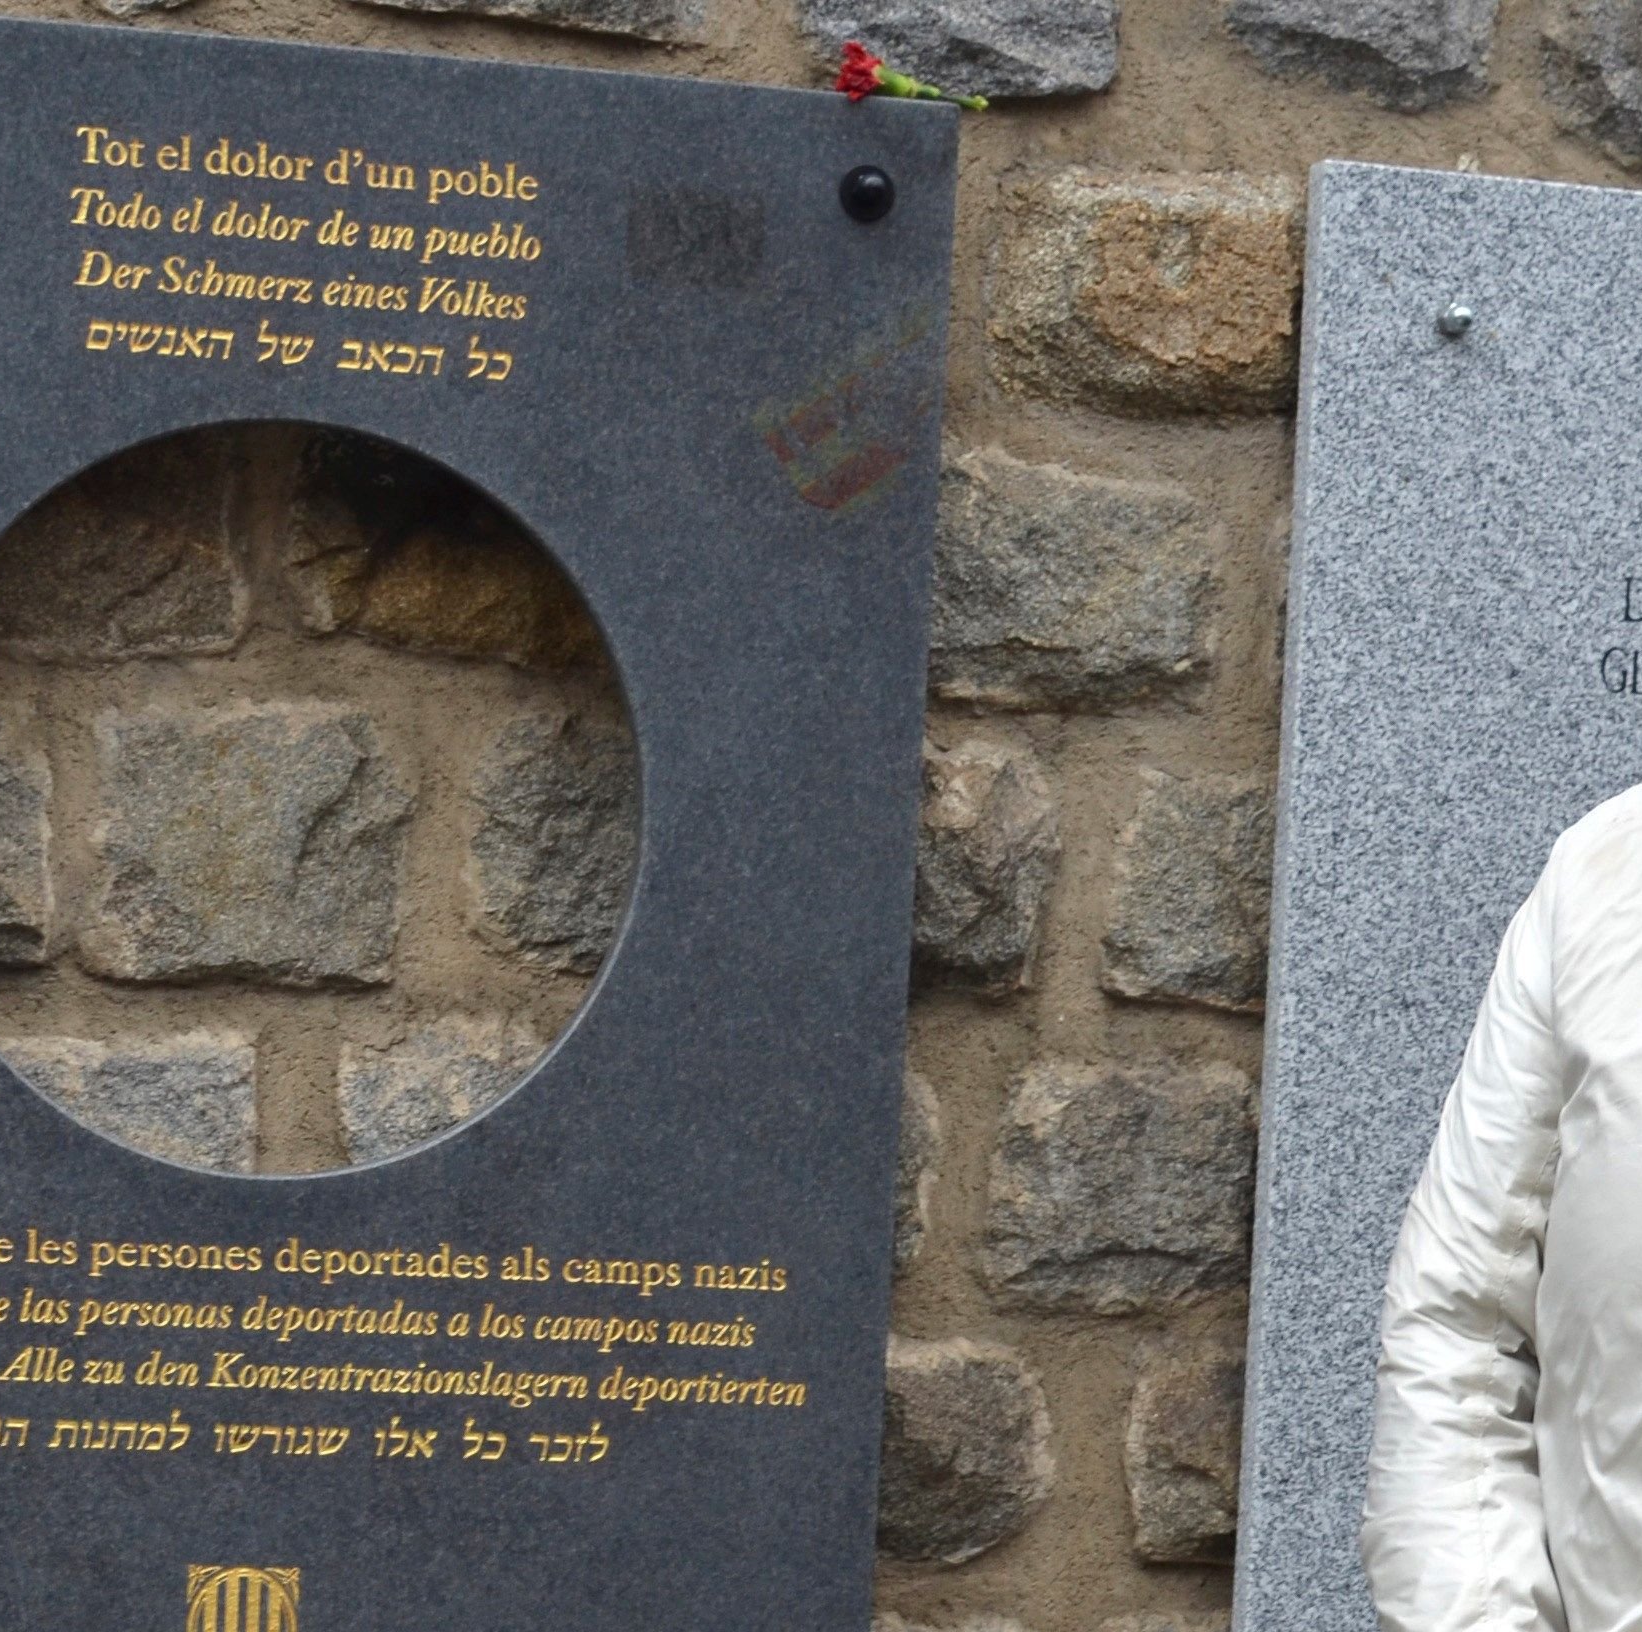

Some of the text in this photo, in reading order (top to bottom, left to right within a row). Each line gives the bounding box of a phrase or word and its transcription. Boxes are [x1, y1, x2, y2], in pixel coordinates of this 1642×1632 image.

[76, 125, 539, 204] Tot el dolor d'un poble
[71, 186, 542, 264] Todo el dolor de un pueblo
[75, 249, 526, 319] Der Schmerz eines Volkes
[85, 319, 513, 381] כל הכאב של האנשים
[26, 1227, 78, 1265] les
[89, 1241, 263, 1277] persones
[273, 1237, 490, 1285] deportades
[500, 1244, 551, 1282] als
[562, 1259, 682, 1296] camps
[694, 1258, 787, 1292] nazis
[18, 1287, 70, 1324] las
[75, 1298, 234, 1337] personas
[241, 1295, 438, 1343] deportadas
[446, 1312, 469, 1337] a
[478, 1302, 525, 1339] los
[533, 1315, 659, 1354] campos
[667, 1316, 755, 1347] nazis
[83, 1359, 125, 1385] zu
[134, 1349, 198, 1387] den
[208, 1351, 589, 1408] Konzentrazionslagern
[597, 1364, 806, 1413] deportierten
[48, 1408, 191, 1452] למחנות
[214, 1423, 351, 1456] שגורשו
[374, 1415, 438, 1458] אלו
[463, 1417, 508, 1461] כל
[529, 1420, 611, 1463] לזכר
